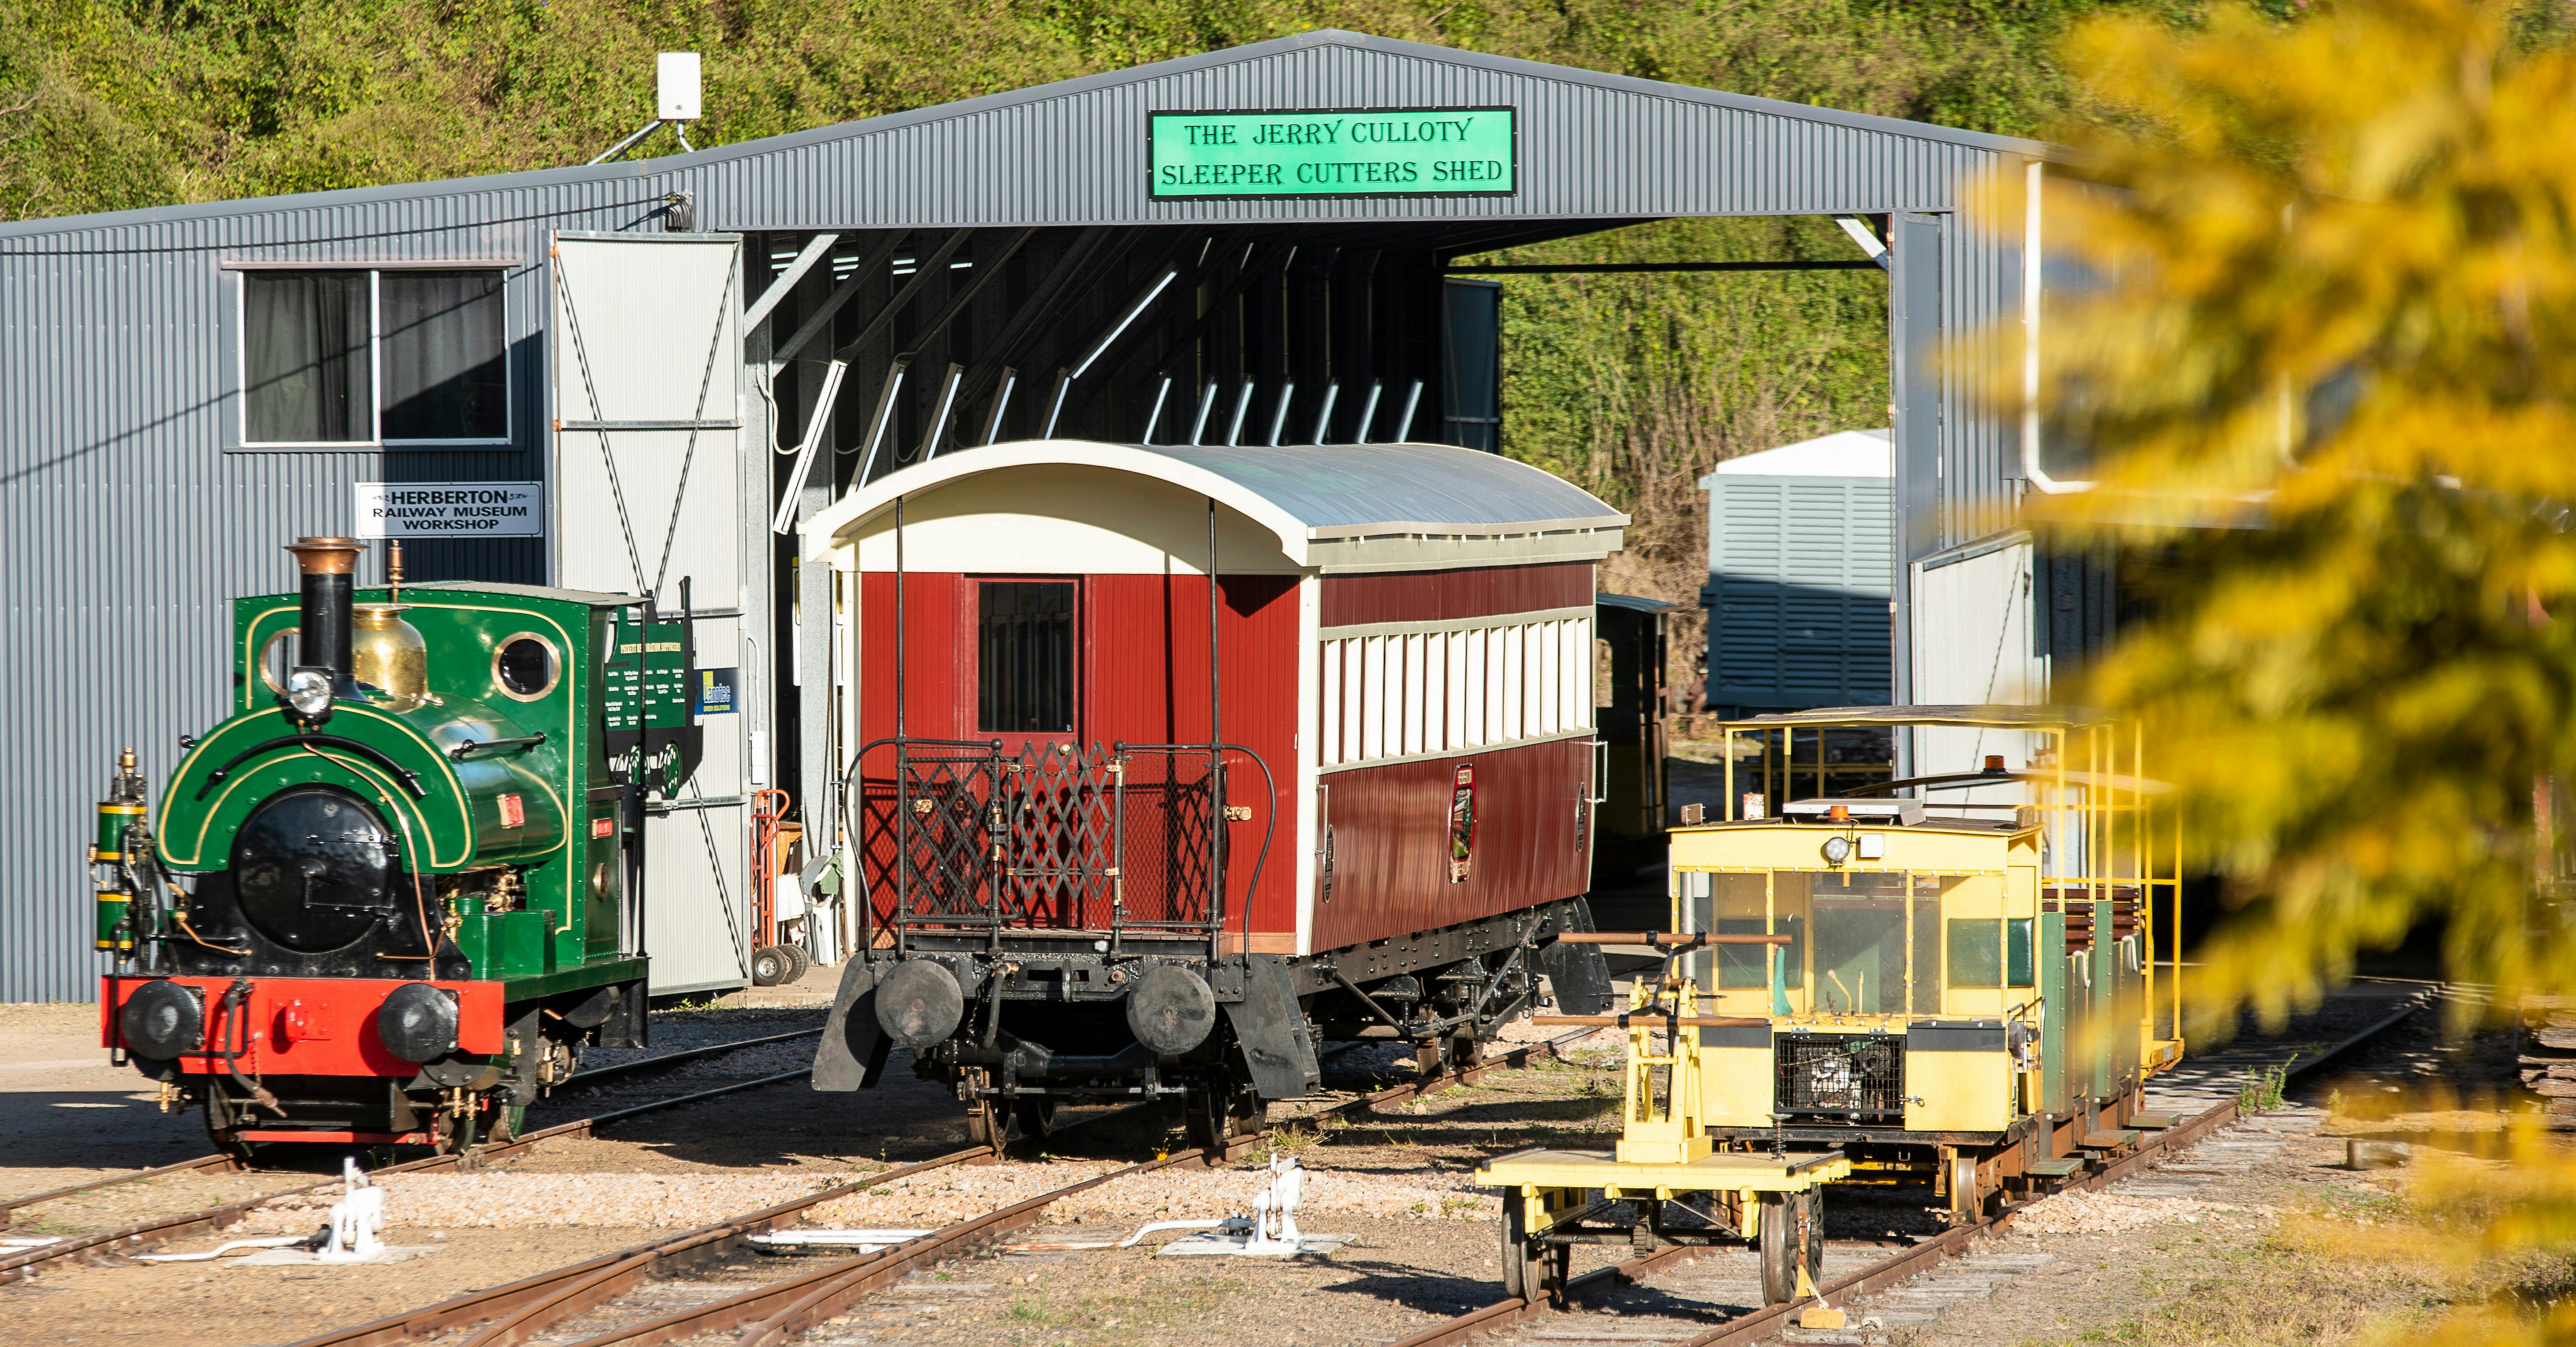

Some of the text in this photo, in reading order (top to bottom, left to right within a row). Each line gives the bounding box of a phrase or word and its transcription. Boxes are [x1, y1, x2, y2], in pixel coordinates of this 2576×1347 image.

[1184, 117, 1474, 146] THE JERRY CULLOTY
[1161, 160, 1502, 186] SLEEPER CUTTERS SHED
[391, 490, 508, 505] HERBERTON
[373, 506, 527, 518] RAILWAY MUSEUM
[403, 520, 499, 530] WORKSHOP
[703, 683, 731, 704] Lanotec
